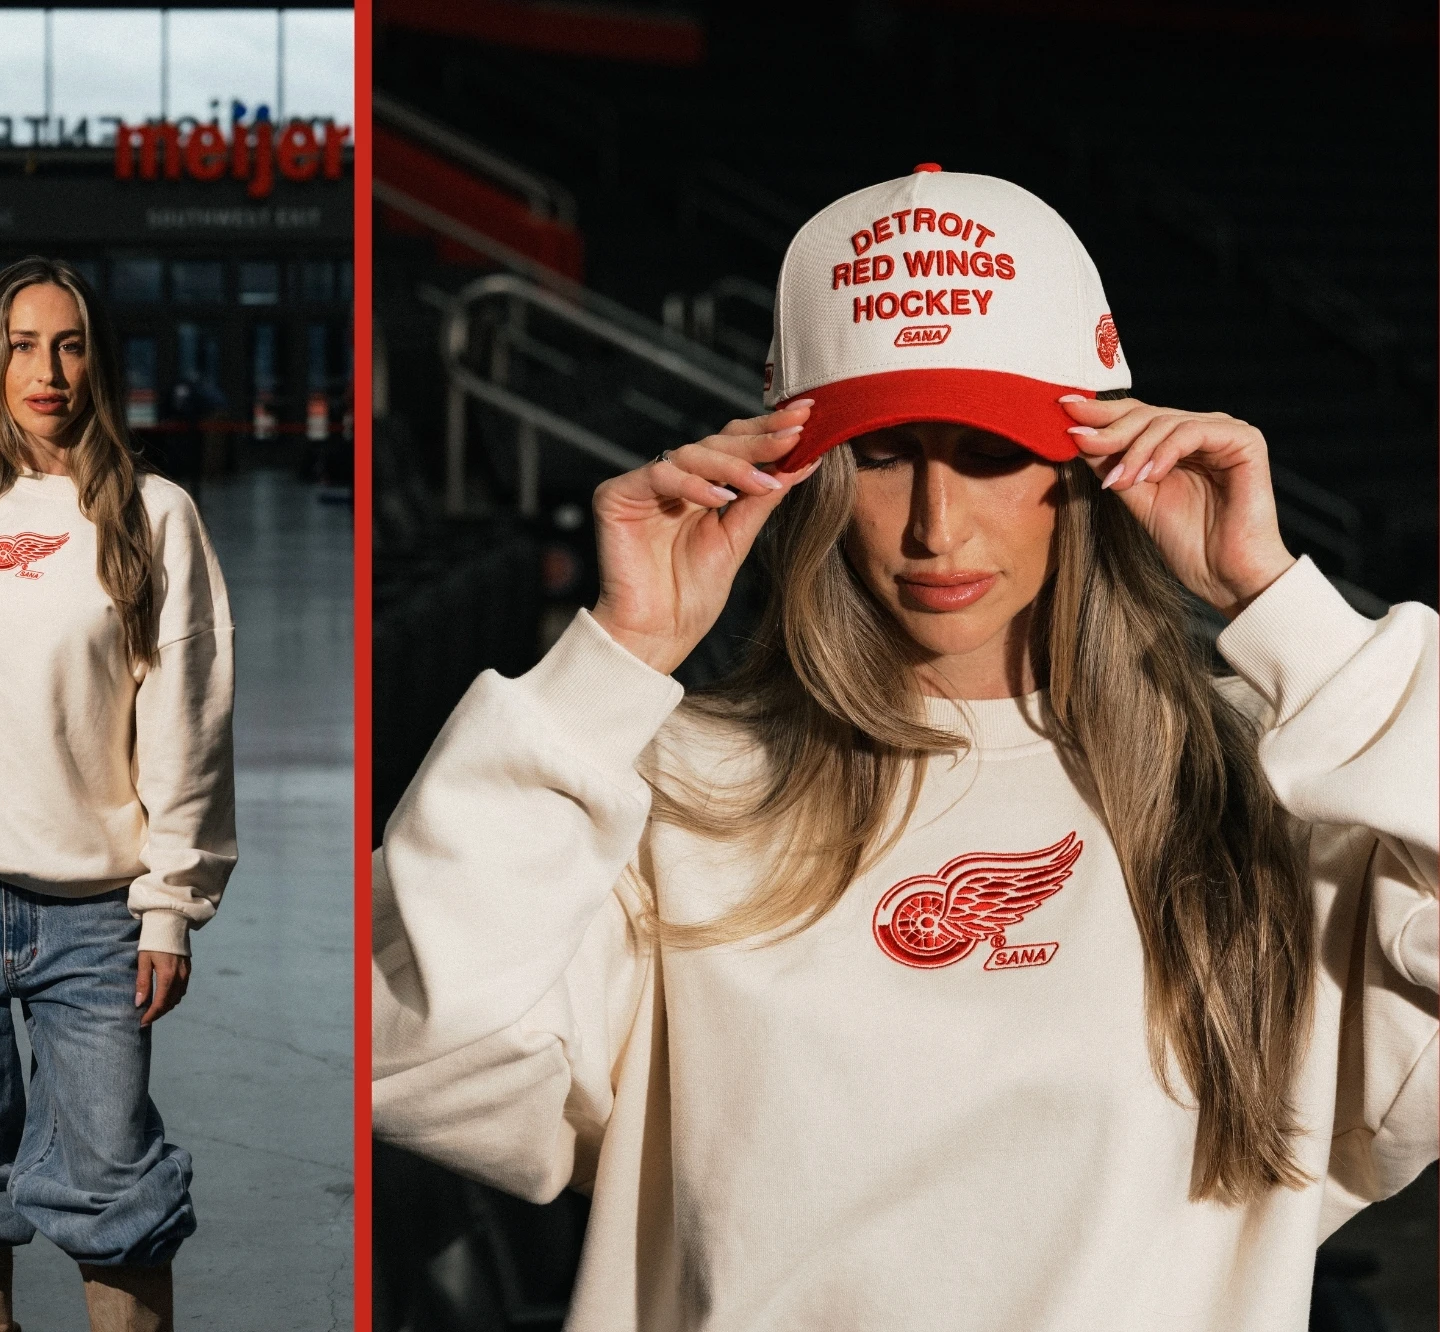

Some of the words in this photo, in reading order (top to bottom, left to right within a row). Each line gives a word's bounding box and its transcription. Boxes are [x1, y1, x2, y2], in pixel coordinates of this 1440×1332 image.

[114, 104, 352, 198] meijer
[851, 207, 996, 256] DETROIT
[832, 255, 895, 290] RED
[903, 250, 1016, 280] WINGS
[853, 289, 993, 323] HOCKEY
[903, 330, 943, 342] SANA
[20, 571, 39, 579] SANA
[994, 948, 1047, 966] SANA
